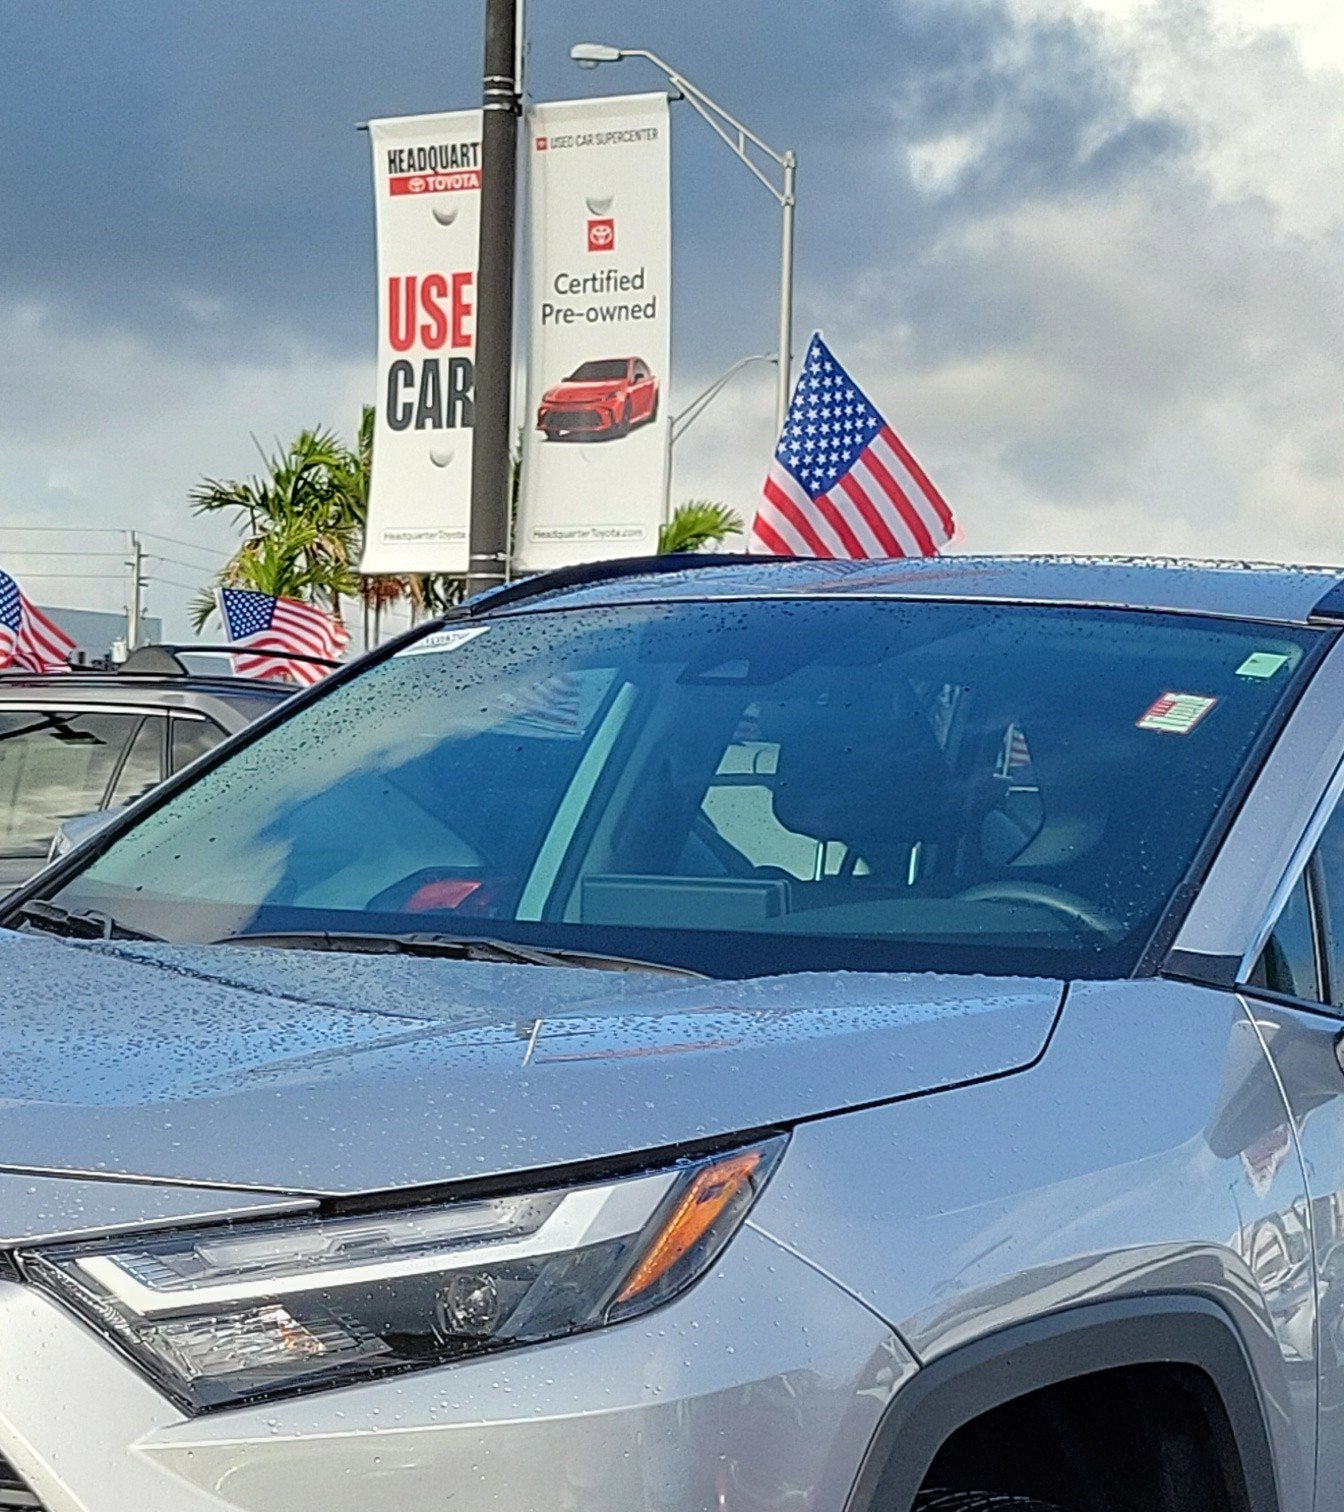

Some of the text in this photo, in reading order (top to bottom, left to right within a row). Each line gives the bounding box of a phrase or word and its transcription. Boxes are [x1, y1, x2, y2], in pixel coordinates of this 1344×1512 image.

[387, 142, 480, 174] HEADQUART
[425, 173, 479, 191] TOYOTA
[554, 266, 644, 294] Certified
[389, 272, 473, 351] USE
[542, 295, 656, 325] Pre-owned
[386, 357, 476, 431] CAR
[383, 529, 467, 541] HeadquarterToyota
